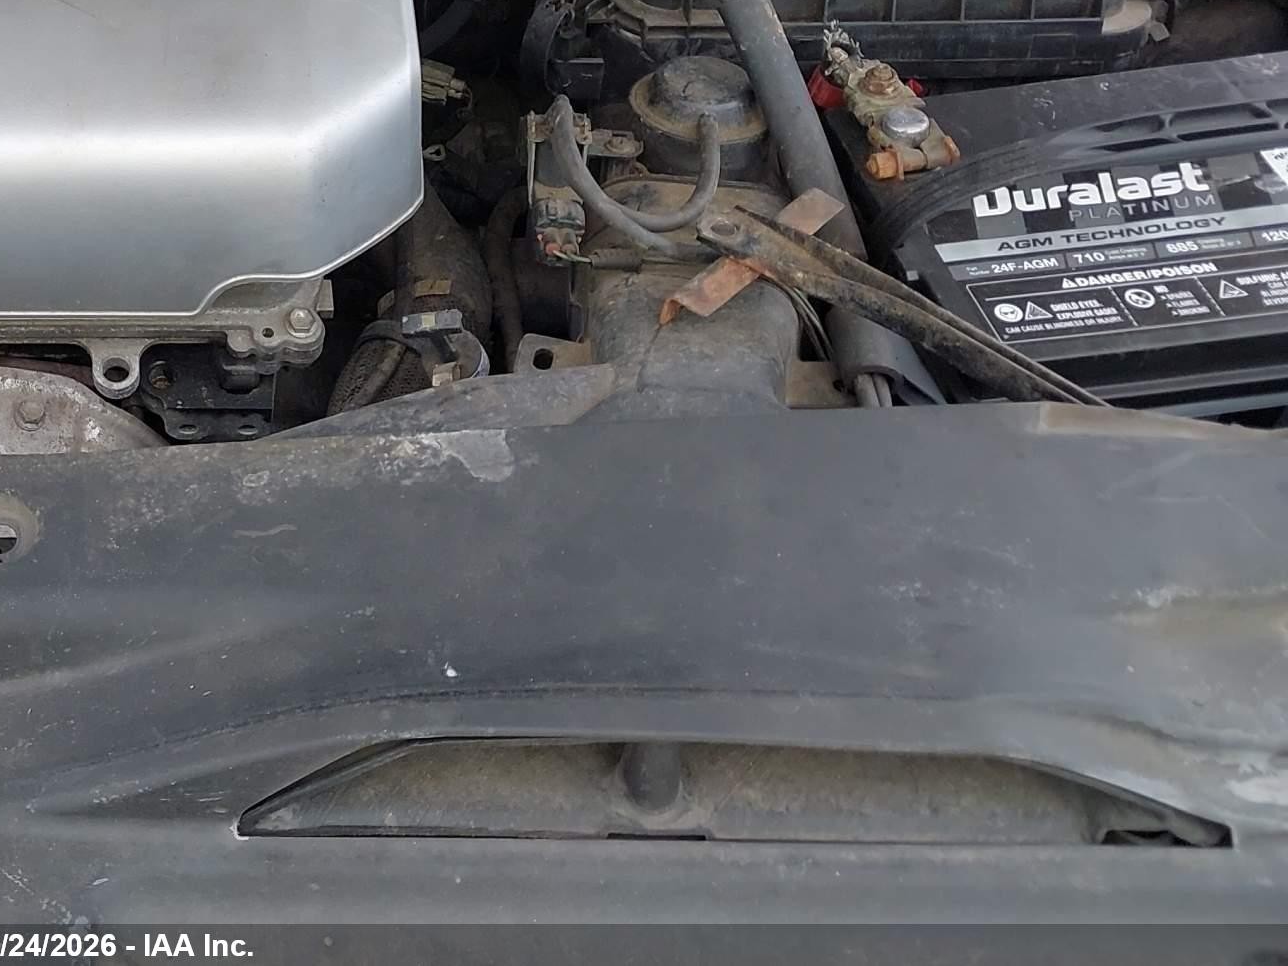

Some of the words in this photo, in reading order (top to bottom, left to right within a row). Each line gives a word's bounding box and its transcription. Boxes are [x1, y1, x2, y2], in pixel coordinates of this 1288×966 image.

[972, 161, 1210, 218] Duralast
[1069, 194, 1216, 222] PLATINUM
[997, 237, 1054, 251] AGM
[1060, 216, 1227, 244] TECHNOLOGY
[991, 257, 1059, 274] 24F-AGM
[1072, 251, 1105, 265] 710
[1075, 262, 1218, 287] DANGER/POISON
